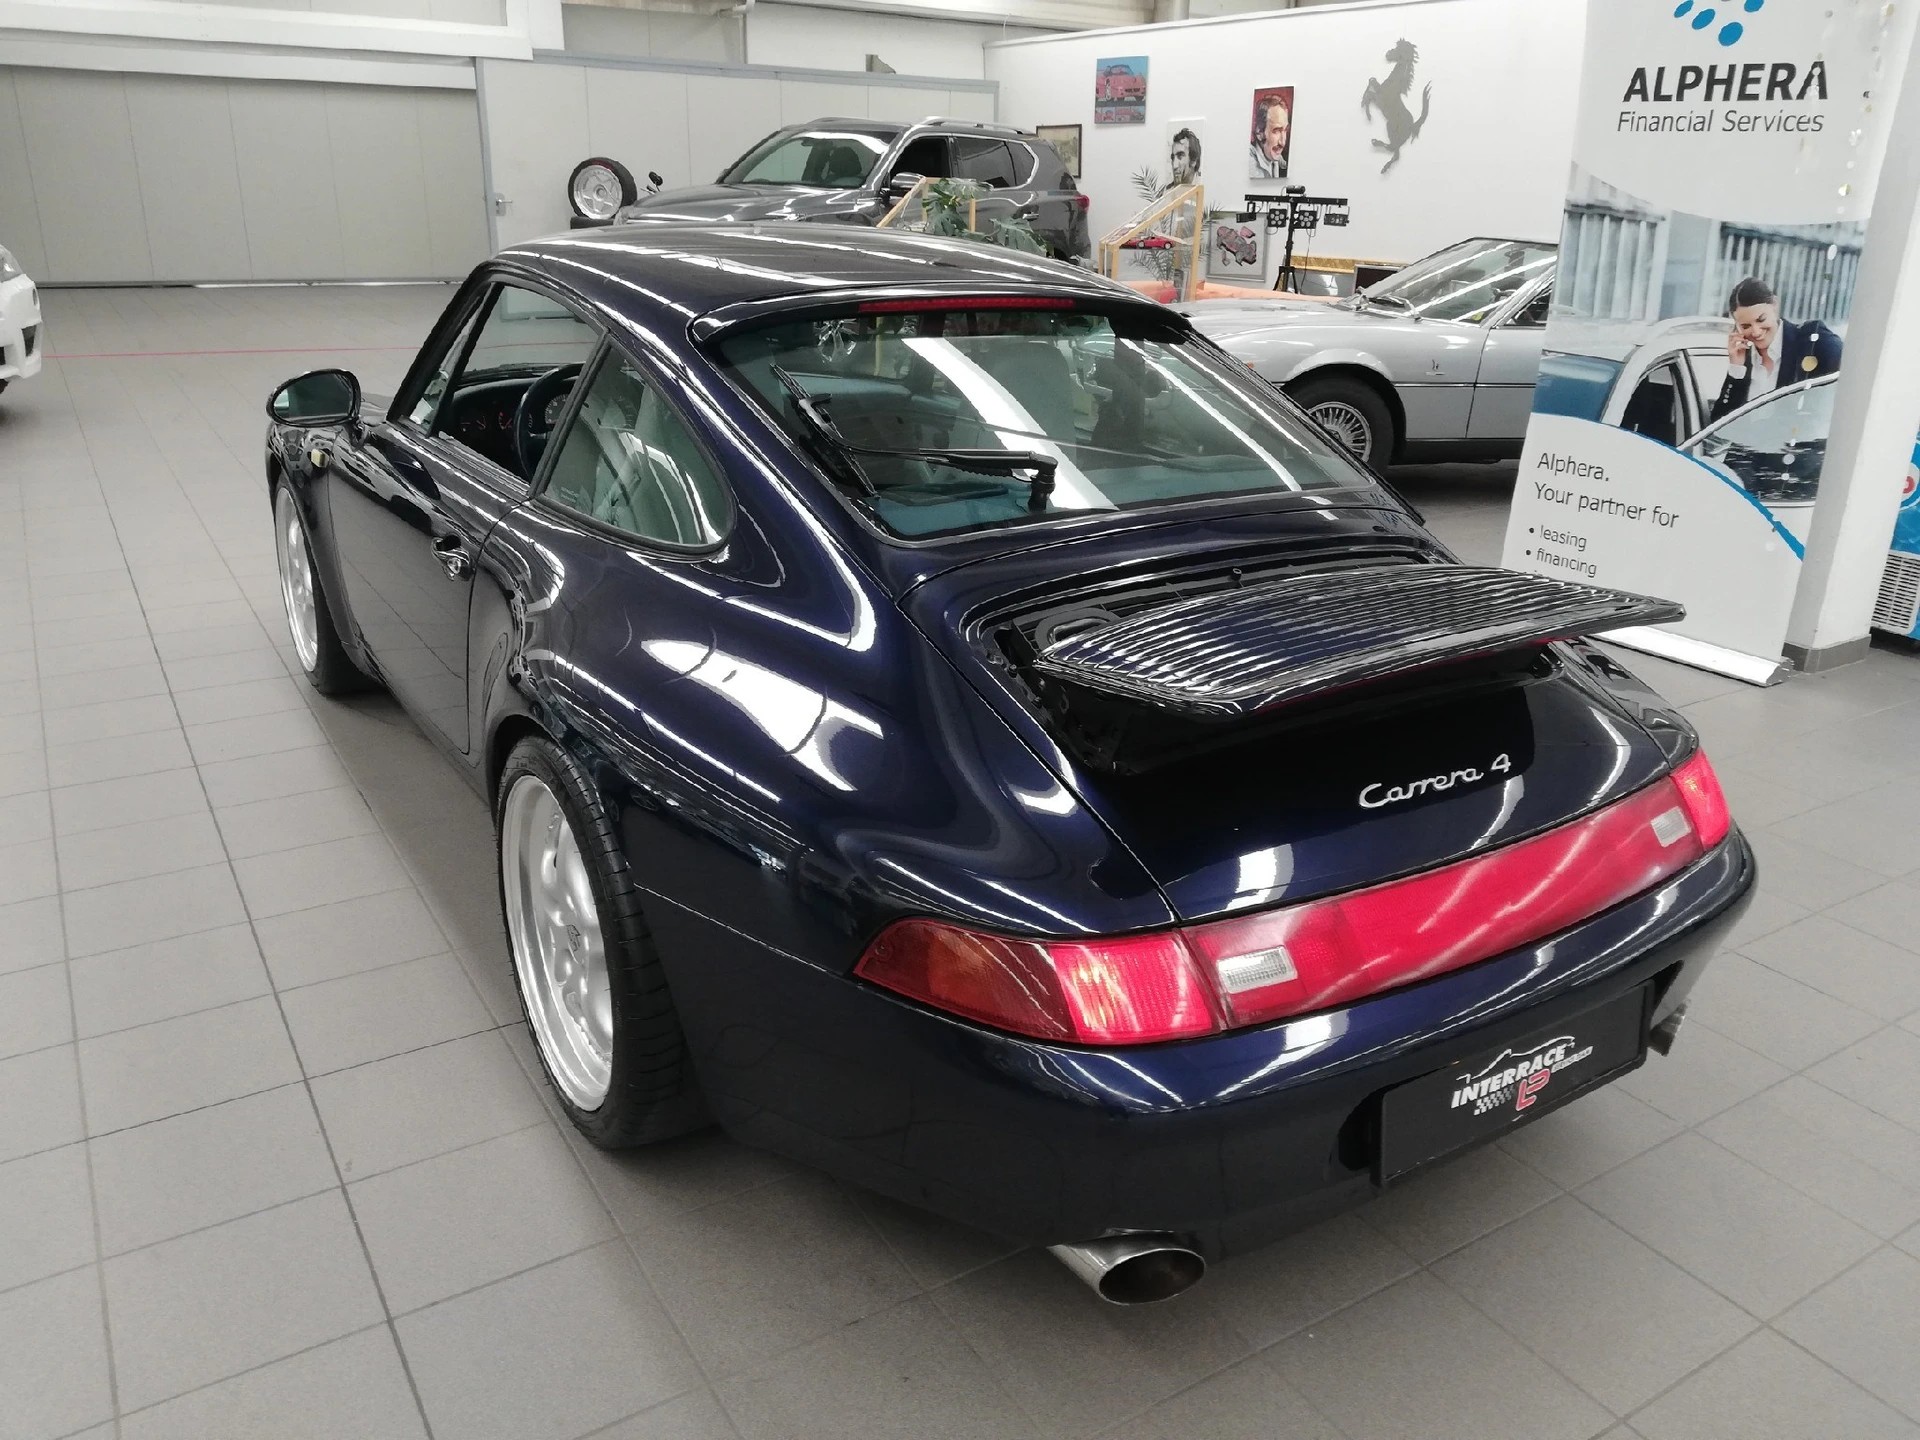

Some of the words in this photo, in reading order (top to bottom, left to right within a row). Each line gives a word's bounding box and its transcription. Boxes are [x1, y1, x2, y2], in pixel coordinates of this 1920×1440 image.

[1622, 61, 1828, 102] ALPHERA
[1617, 109, 1714, 132] Financial
[1721, 109, 1825, 132] Services
[1537, 452, 1610, 482] Alphera.
[1534, 481, 1574, 505] Your
[1577, 494, 1647, 521] partner
[1651, 505, 1680, 528] for
[1539, 525, 1587, 552] leasing
[1536, 547, 1597, 579] financing
[1358, 768, 1485, 809] Carrera
[1490, 753, 1512, 773] 4
